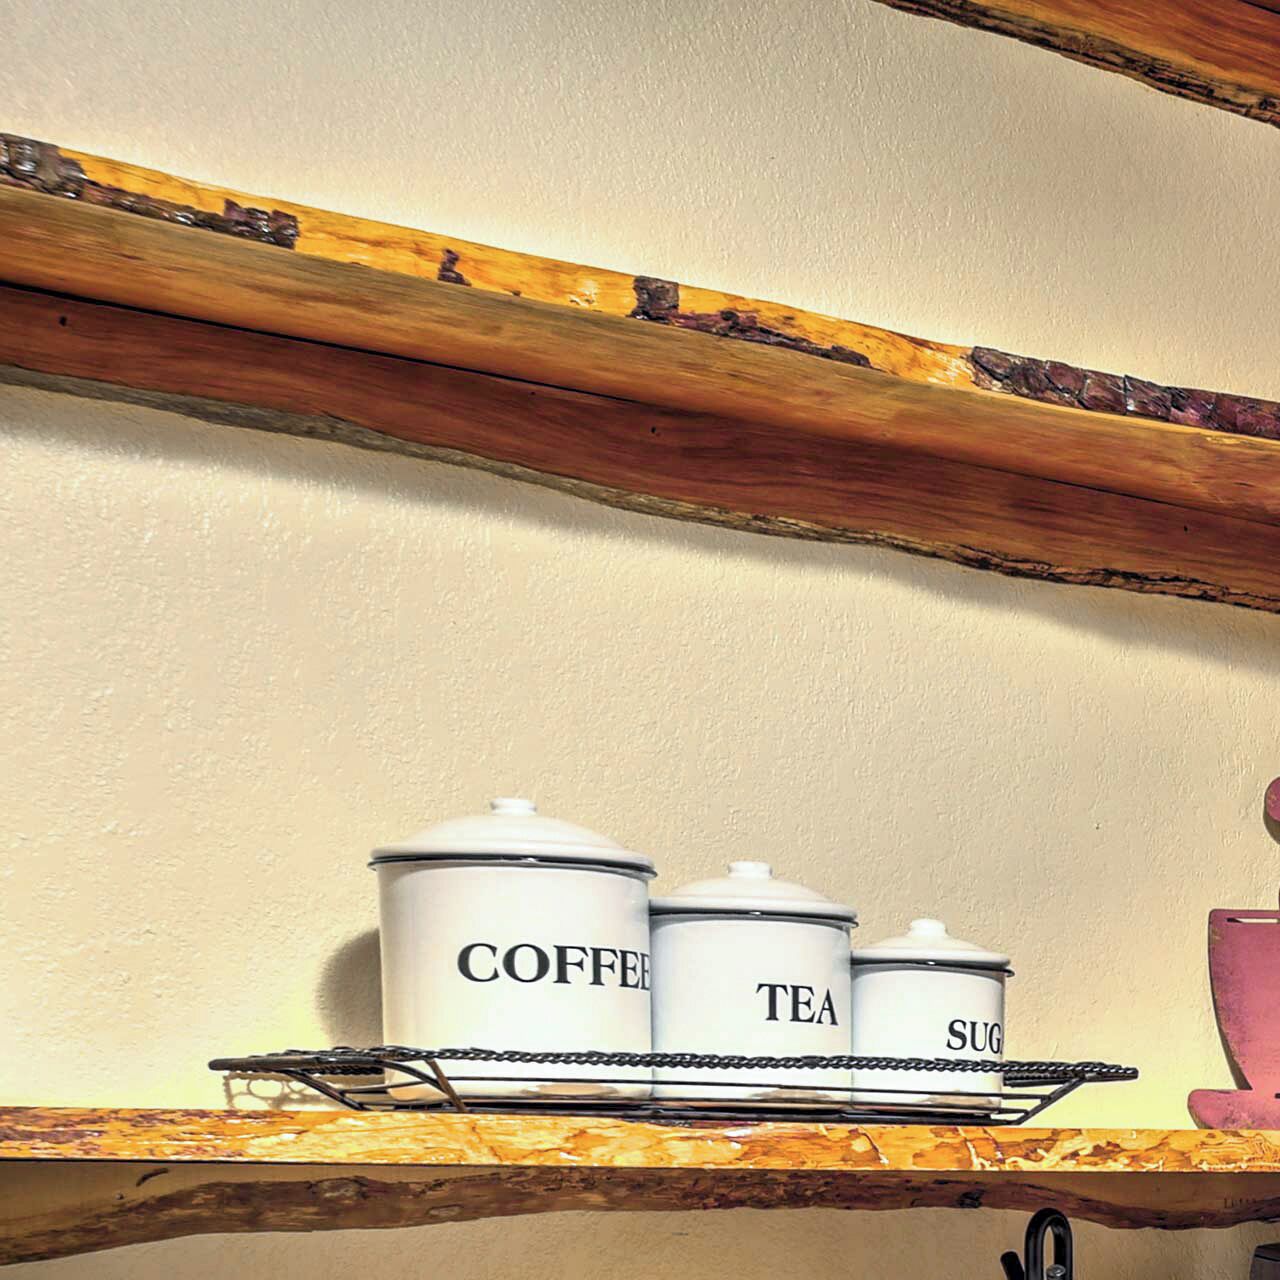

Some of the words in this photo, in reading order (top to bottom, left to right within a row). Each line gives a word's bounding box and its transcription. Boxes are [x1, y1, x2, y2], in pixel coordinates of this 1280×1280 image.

[457, 942, 650, 991] COFFEE
[756, 983, 839, 1025] TEA
[945, 1019, 1003, 1056] SUG
